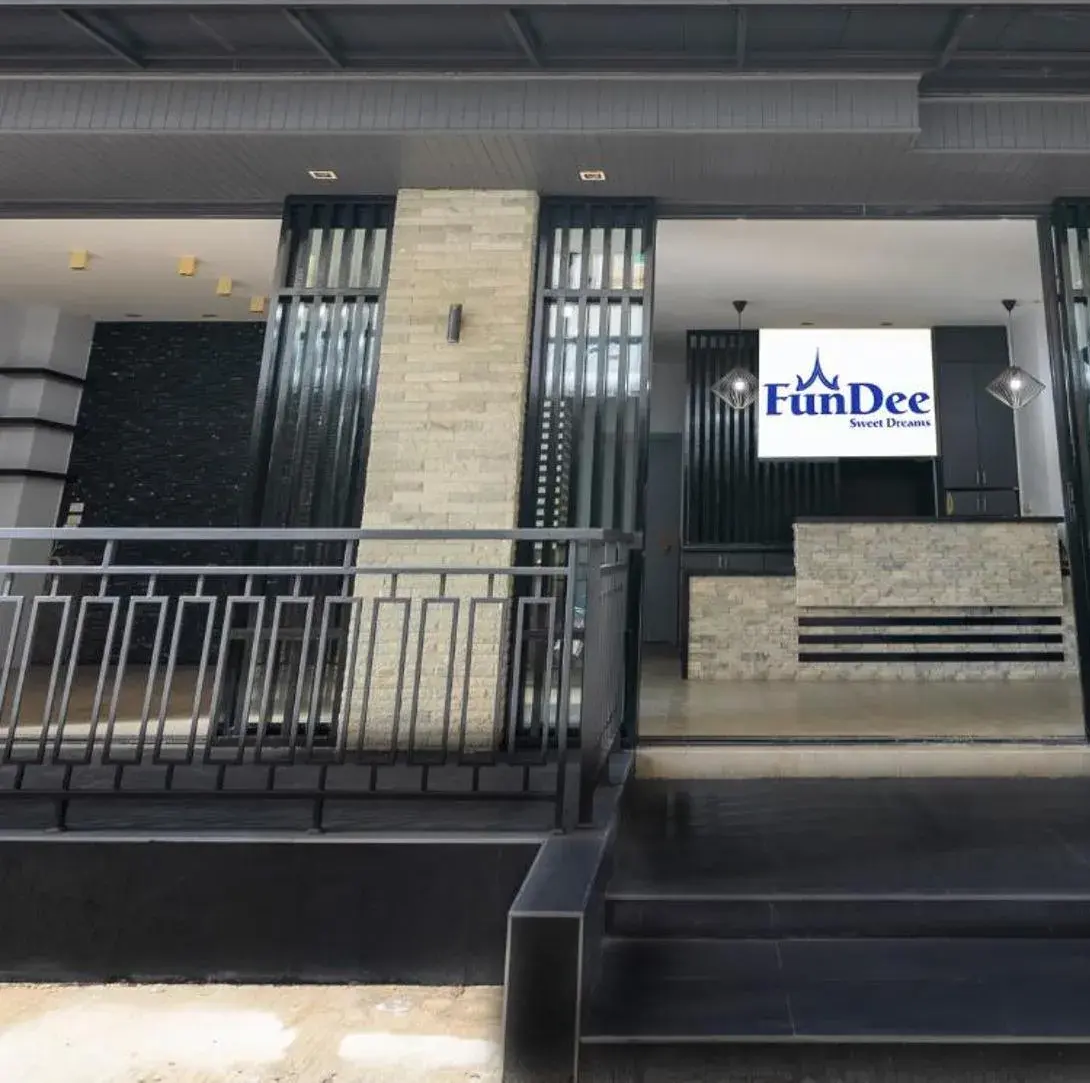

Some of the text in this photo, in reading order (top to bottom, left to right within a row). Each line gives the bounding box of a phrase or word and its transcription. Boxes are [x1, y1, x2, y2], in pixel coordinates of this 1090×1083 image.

[764, 382, 931, 415] FunDee
[849, 418, 931, 428] Sweet Dreams
